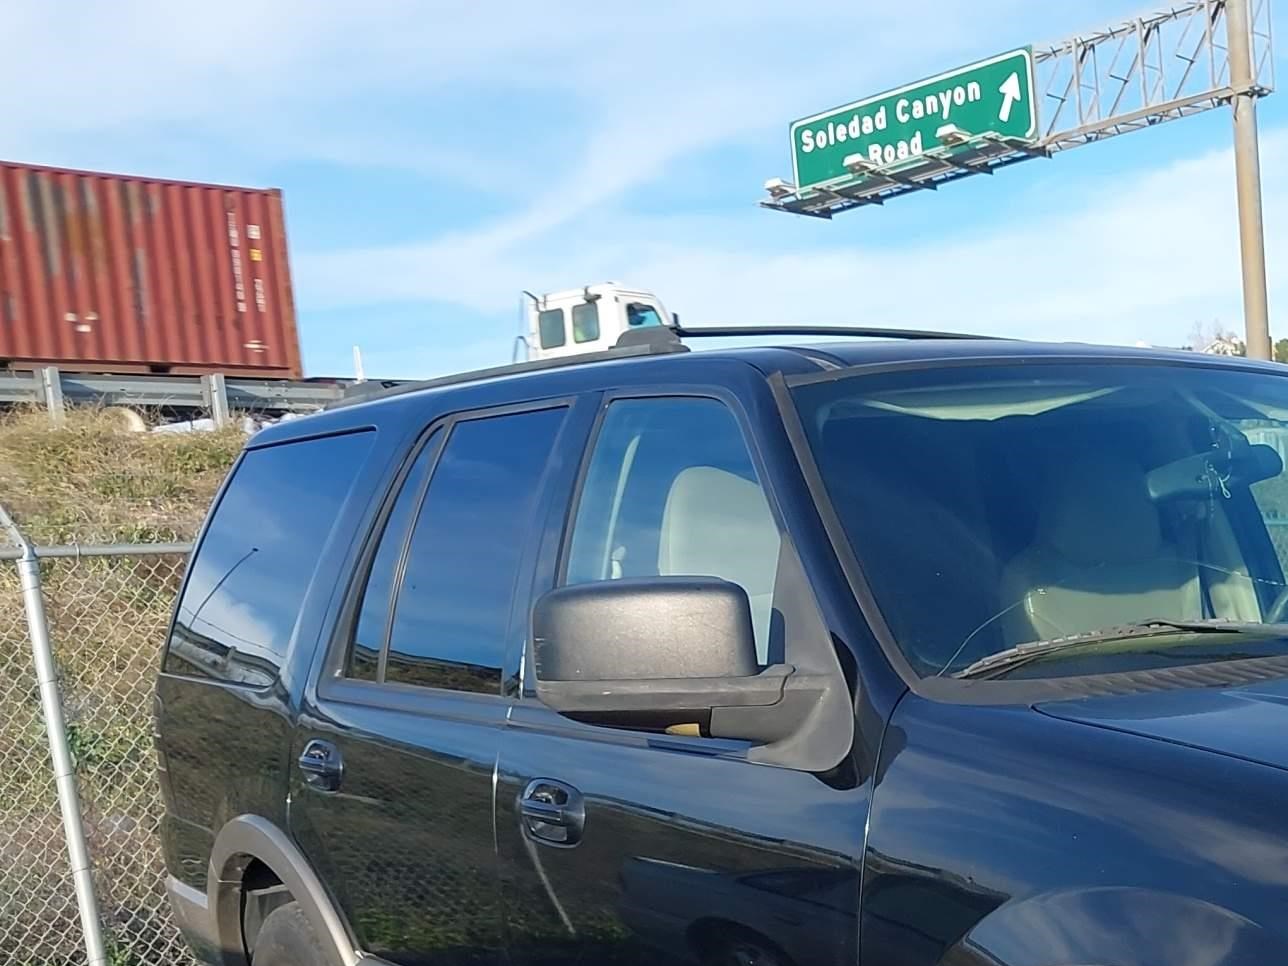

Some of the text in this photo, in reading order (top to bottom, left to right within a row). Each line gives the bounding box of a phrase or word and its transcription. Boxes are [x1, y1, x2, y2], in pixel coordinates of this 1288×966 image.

[801, 81, 981, 153] Soledad Canyon
[868, 130, 923, 166] Road
